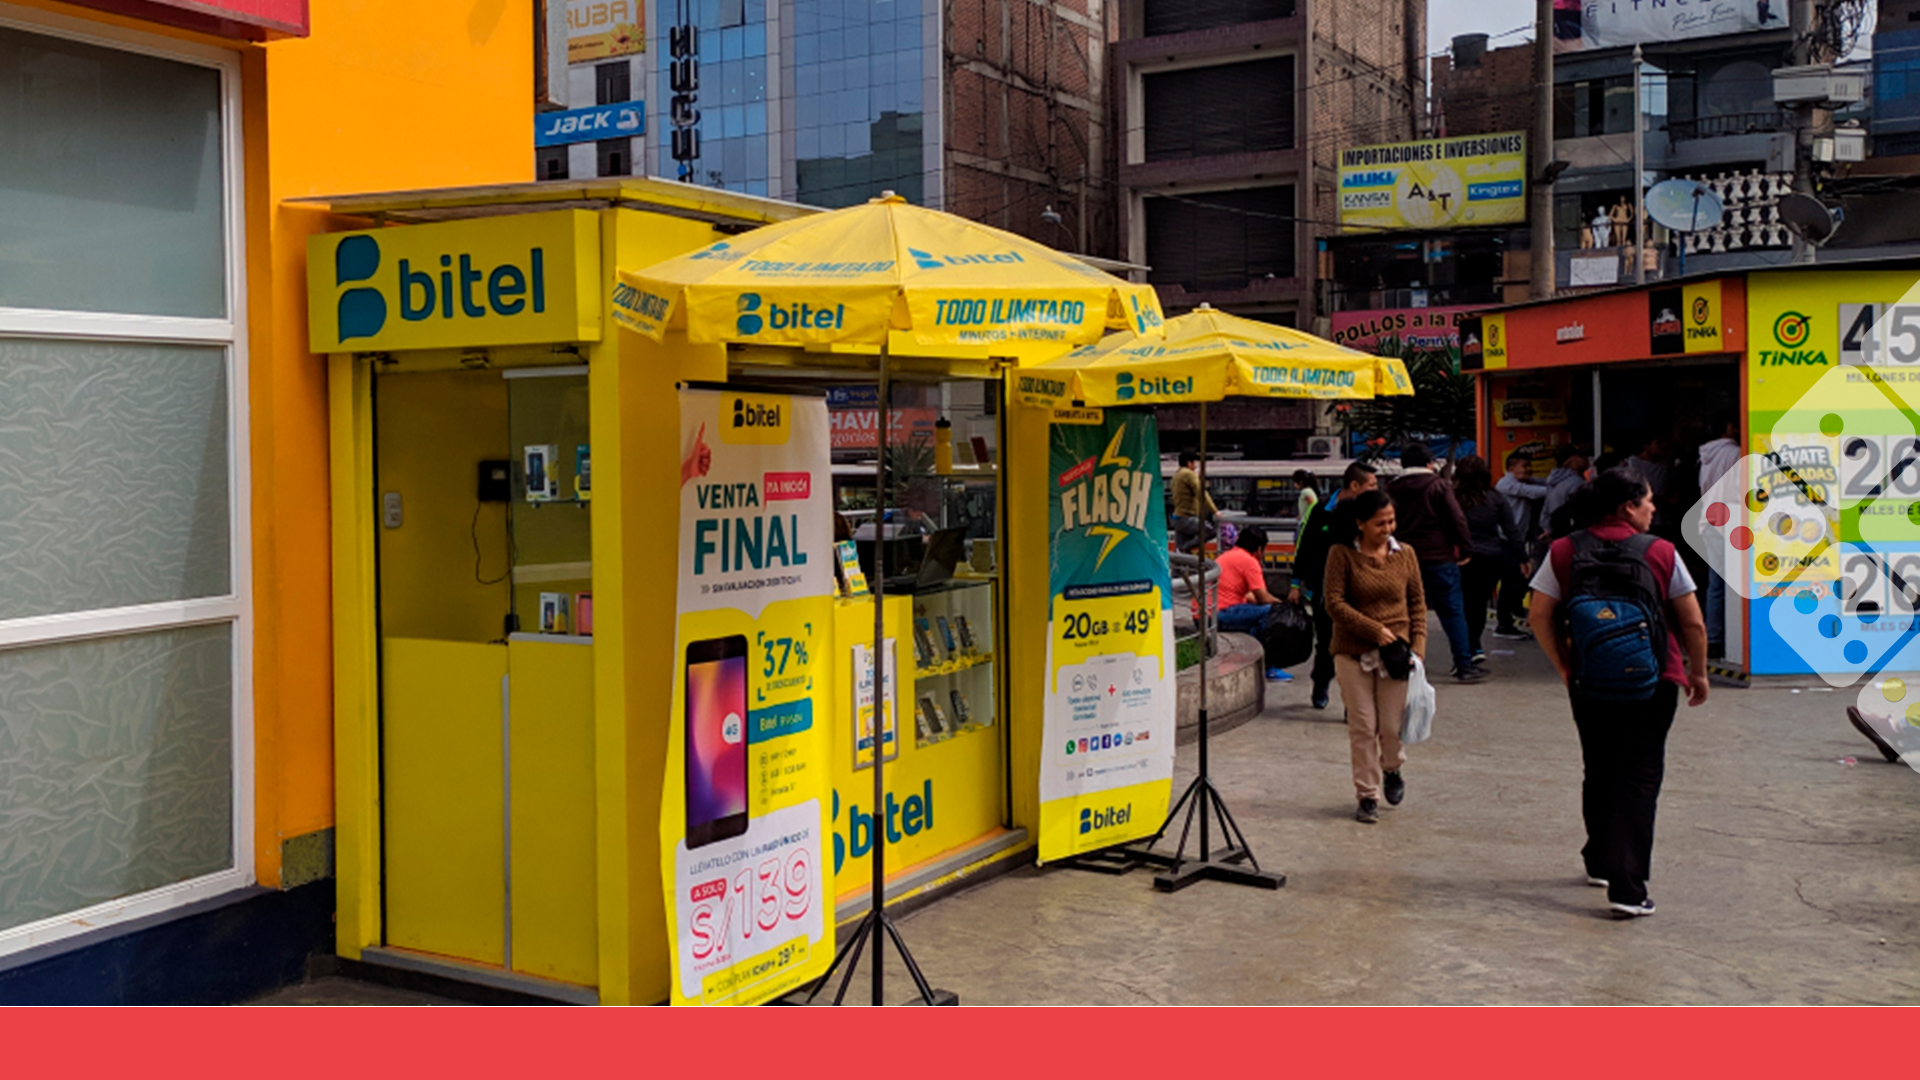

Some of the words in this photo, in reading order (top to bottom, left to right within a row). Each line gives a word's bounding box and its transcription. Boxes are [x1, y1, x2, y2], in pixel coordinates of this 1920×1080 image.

[1342, 144, 1433, 167] IMPORTACIONES
[1436, 143, 1441, 159] E
[1445, 135, 1522, 158] INVERSIONES
[399, 247, 545, 321] bitel
[769, 302, 845, 330] bitel
[935, 299, 987, 326] TODO
[989, 299, 1085, 325] ILIMITADO
[1335, 313, 1406, 344] POLLOS
[1412, 316, 1423, 328] a
[1429, 311, 1446, 328] la
[1139, 376, 1193, 395] bitel
[1251, 365, 1287, 384] TODO
[1289, 366, 1356, 387] ILIMITADO
[1846, 371, 1906, 384] MILLONES
[746, 403, 780, 427] bitel
[696, 483, 759, 510] VENTA
[1061, 468, 1154, 531] FLASH
[1859, 504, 1894, 516] MILES
[1898, 504, 1914, 515] DE
[693, 513, 808, 576] FINAL
[1860, 622, 1896, 632] MILES
[1898, 621, 1916, 632] DE
[763, 637, 809, 678] 37%
[849, 778, 933, 858] btel
[1093, 803, 1131, 830] bitel
[694, 889, 701, 898] A
[702, 881, 725, 896] SOLO
